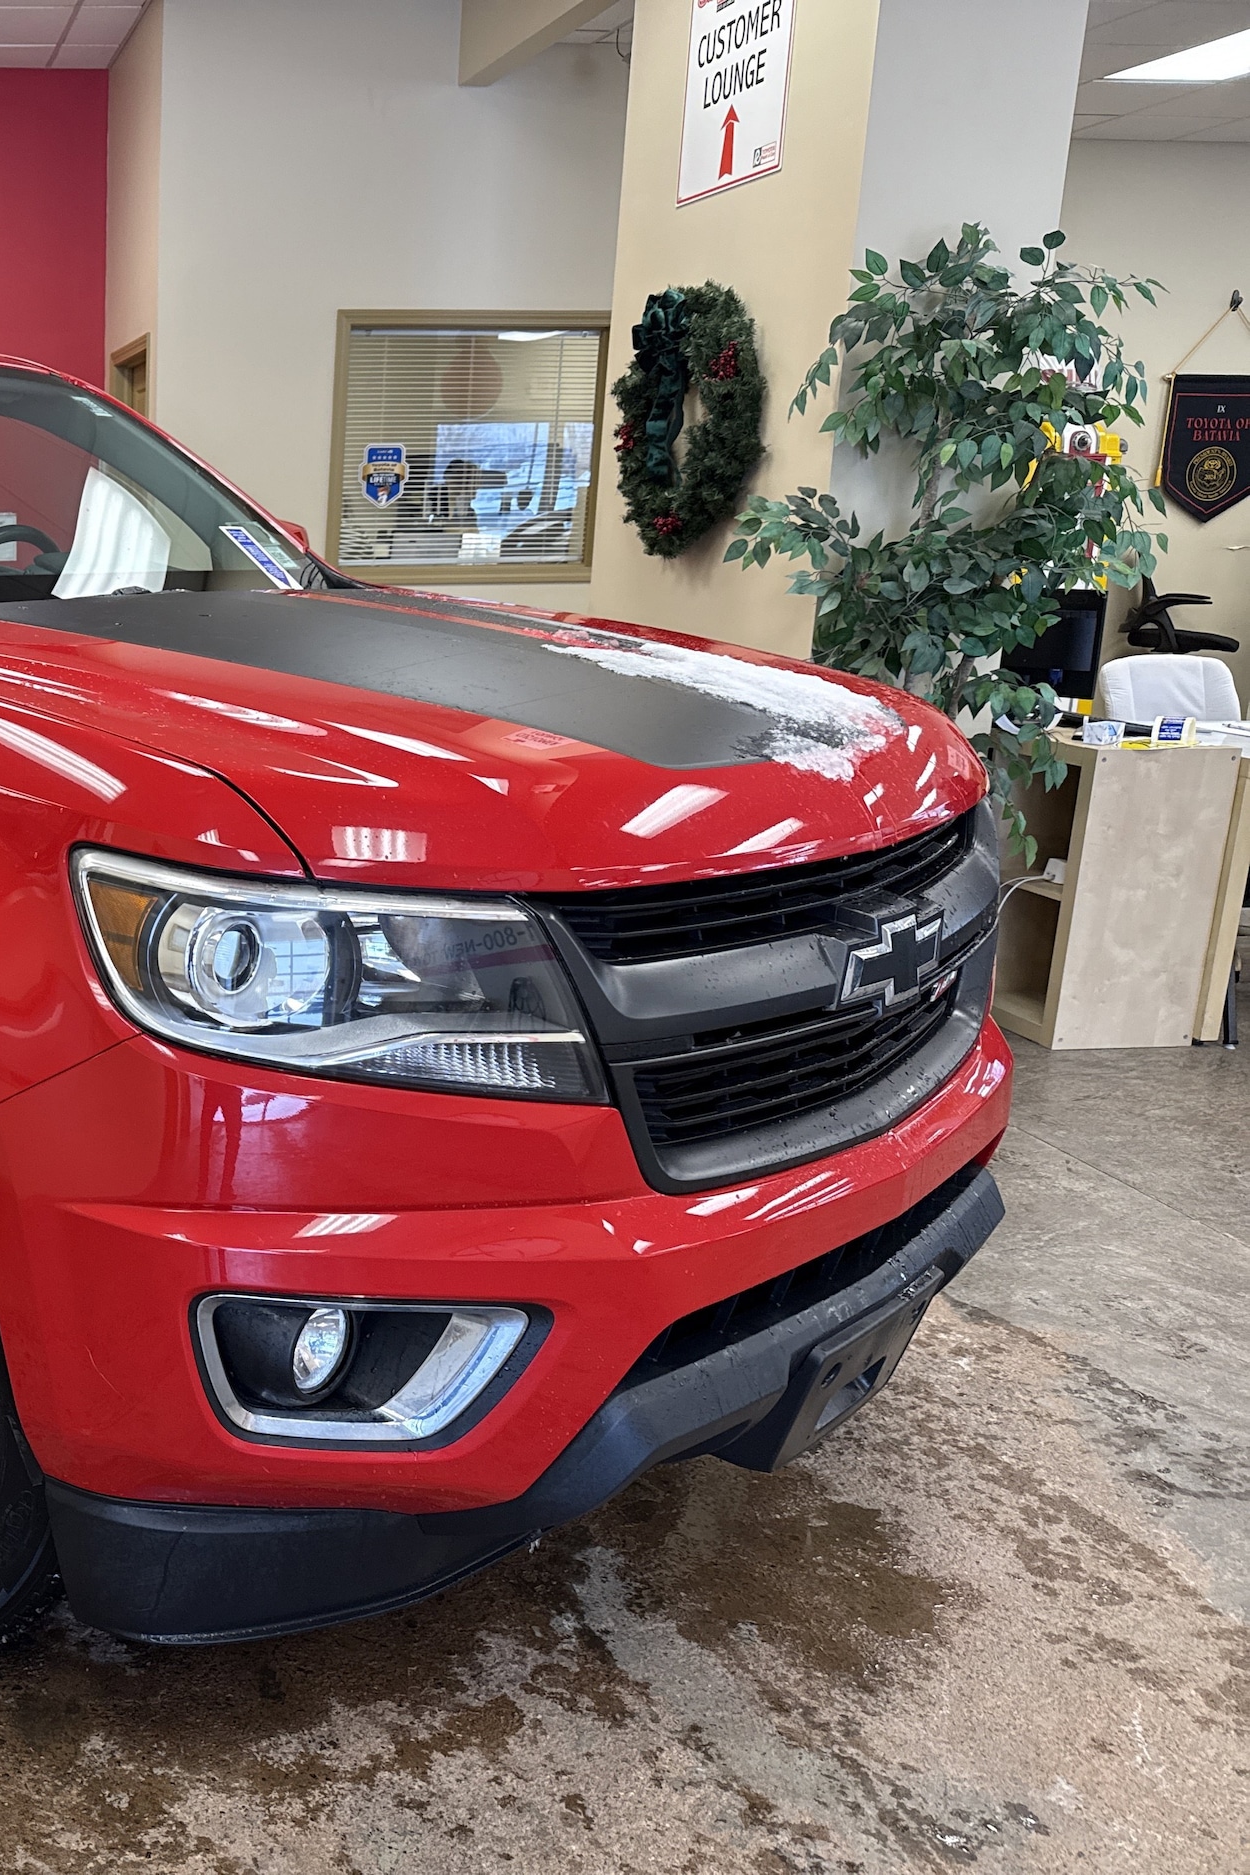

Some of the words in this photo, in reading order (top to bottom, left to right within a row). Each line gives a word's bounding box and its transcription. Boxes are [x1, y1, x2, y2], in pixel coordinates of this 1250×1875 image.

[698, 0, 782, 68] CUSTOMER
[703, 48, 767, 109] LOUNGE
[1216, 405, 1226, 413] IX
[1186, 417, 1231, 429] TOYOTA
[1192, 430, 1241, 441] BATAVIA
